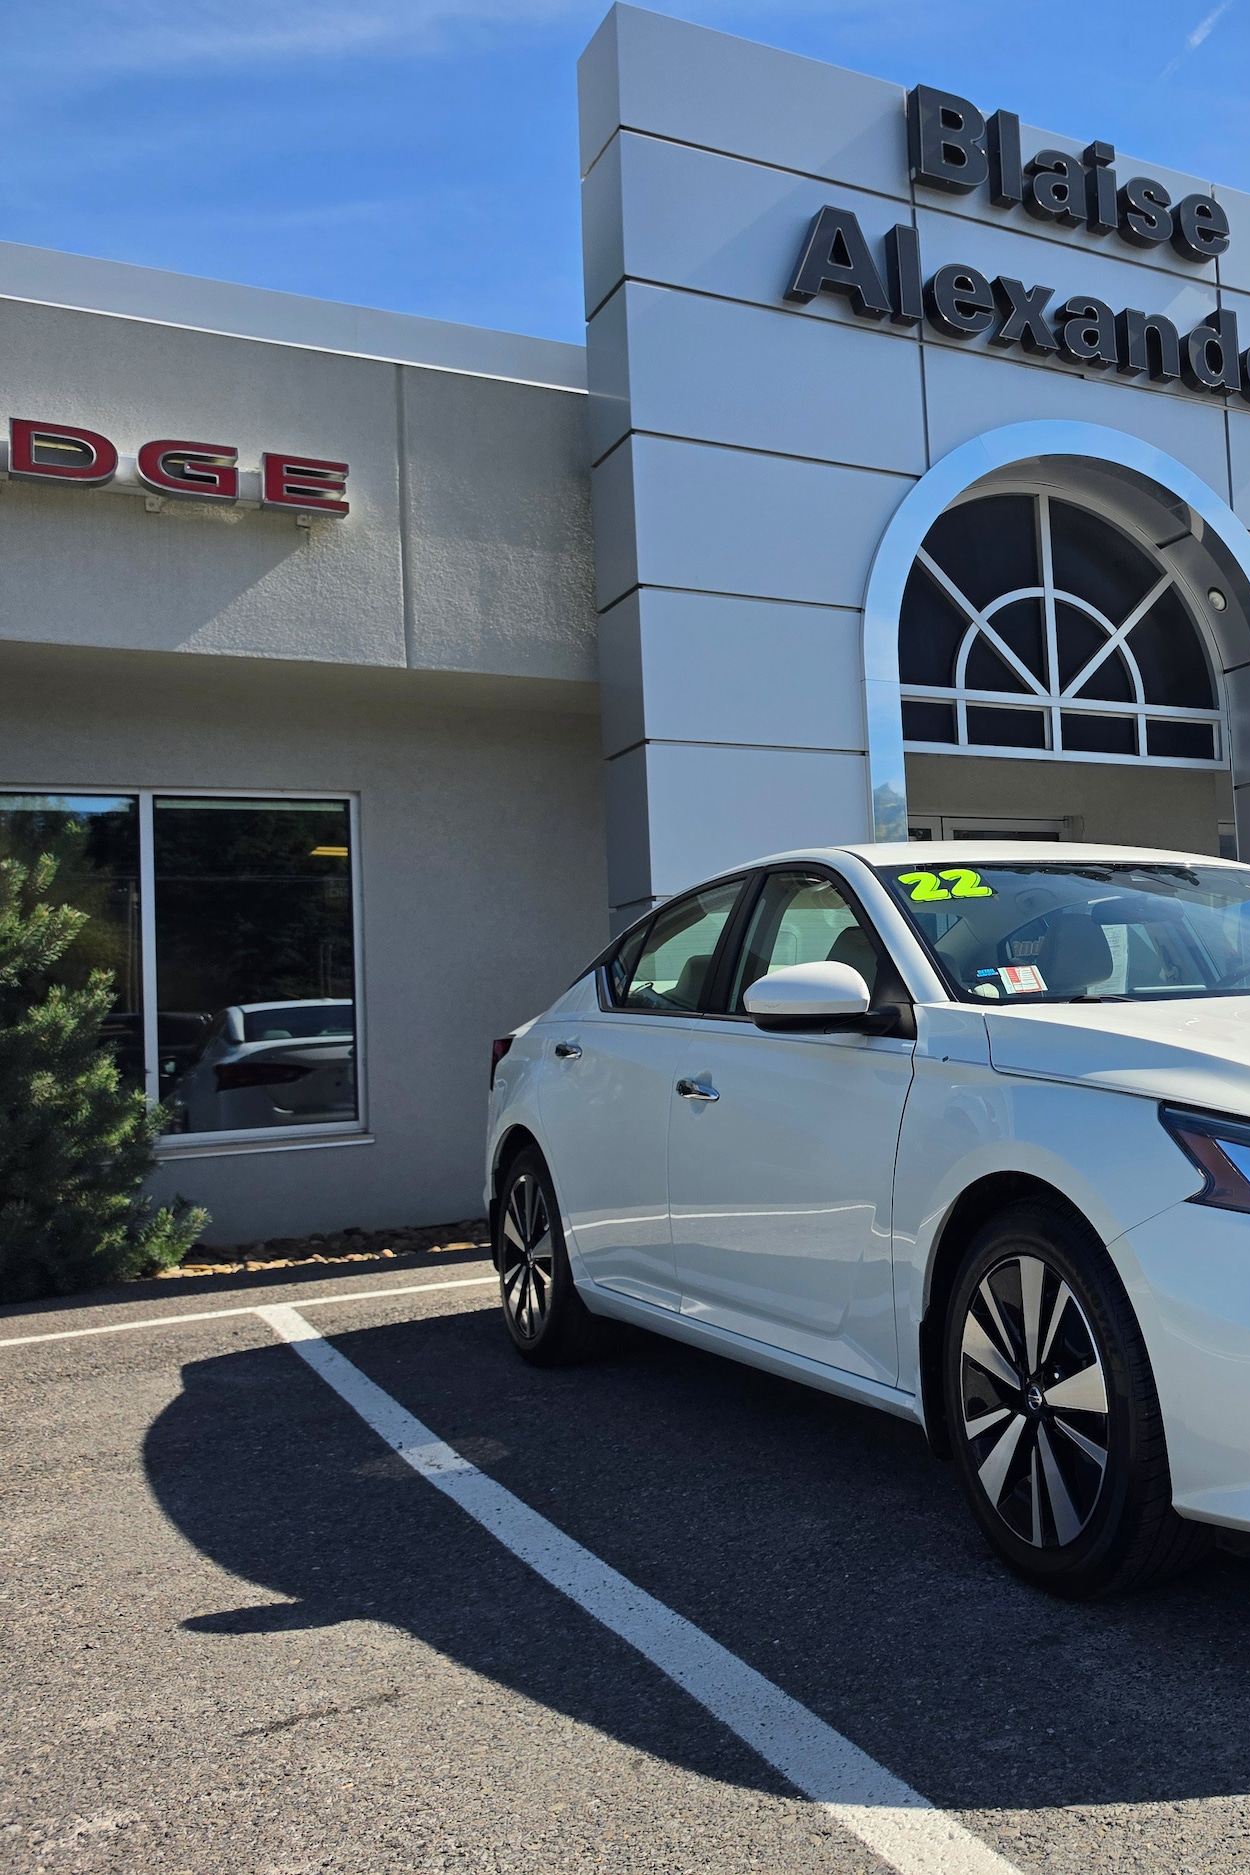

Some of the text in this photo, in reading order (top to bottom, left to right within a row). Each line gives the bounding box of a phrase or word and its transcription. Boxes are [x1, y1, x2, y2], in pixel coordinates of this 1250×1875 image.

[907, 84, 1230, 263] Blaise
[8, 418, 349, 518] DGE
[898, 869, 992, 902] 22
